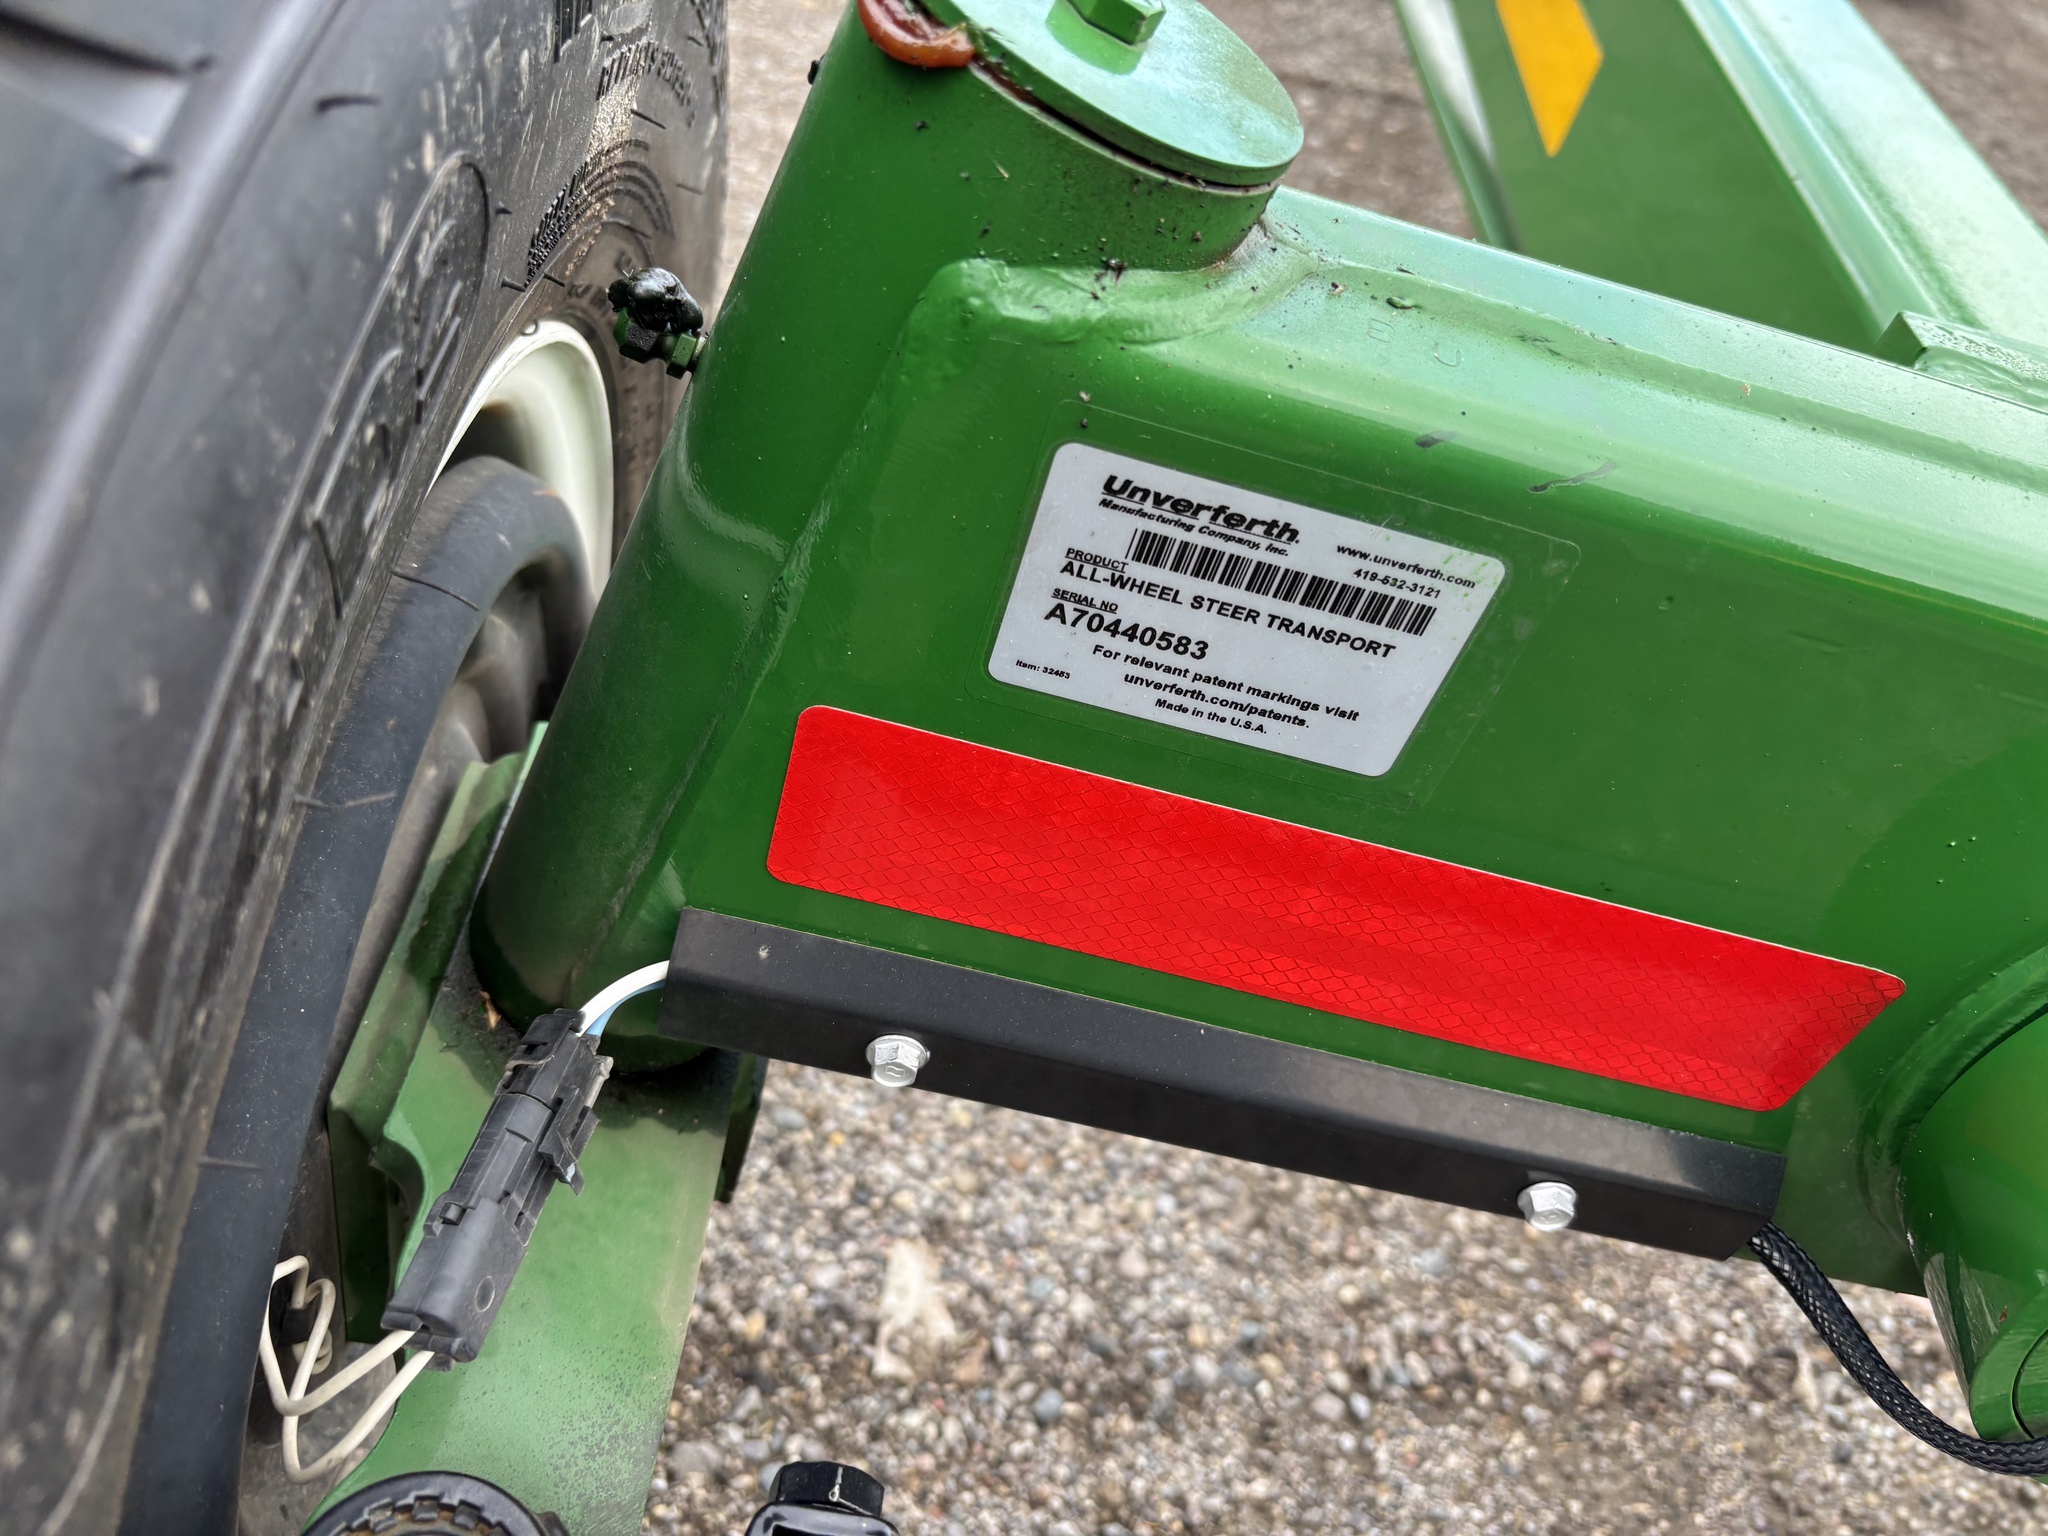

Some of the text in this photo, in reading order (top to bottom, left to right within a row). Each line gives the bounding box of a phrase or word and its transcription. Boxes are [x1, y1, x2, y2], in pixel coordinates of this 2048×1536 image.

[1099, 498, 1288, 556] Manufacturing Company, Inc.
[1102, 475, 1299, 544] Unverferth
[1065, 547, 1129, 573] PRODUCT
[1337, 545, 1476, 589] www.unverferth.com
[1353, 568, 1441, 599] 419-532-3121
[1052, 588, 1119, 614] SERIAL NO
[1060, 561, 1396, 658] ALL-WHEEL STEER TRANSPORT
[1044, 603, 1209, 660] A70440583
[1015, 659, 1040, 671] Item:
[1092, 644, 1360, 721] For relevant patent markings visit
[1124, 673, 1309, 728] unverferth.com/patents.
[1155, 698, 1267, 734] Made in the U.S.A.
